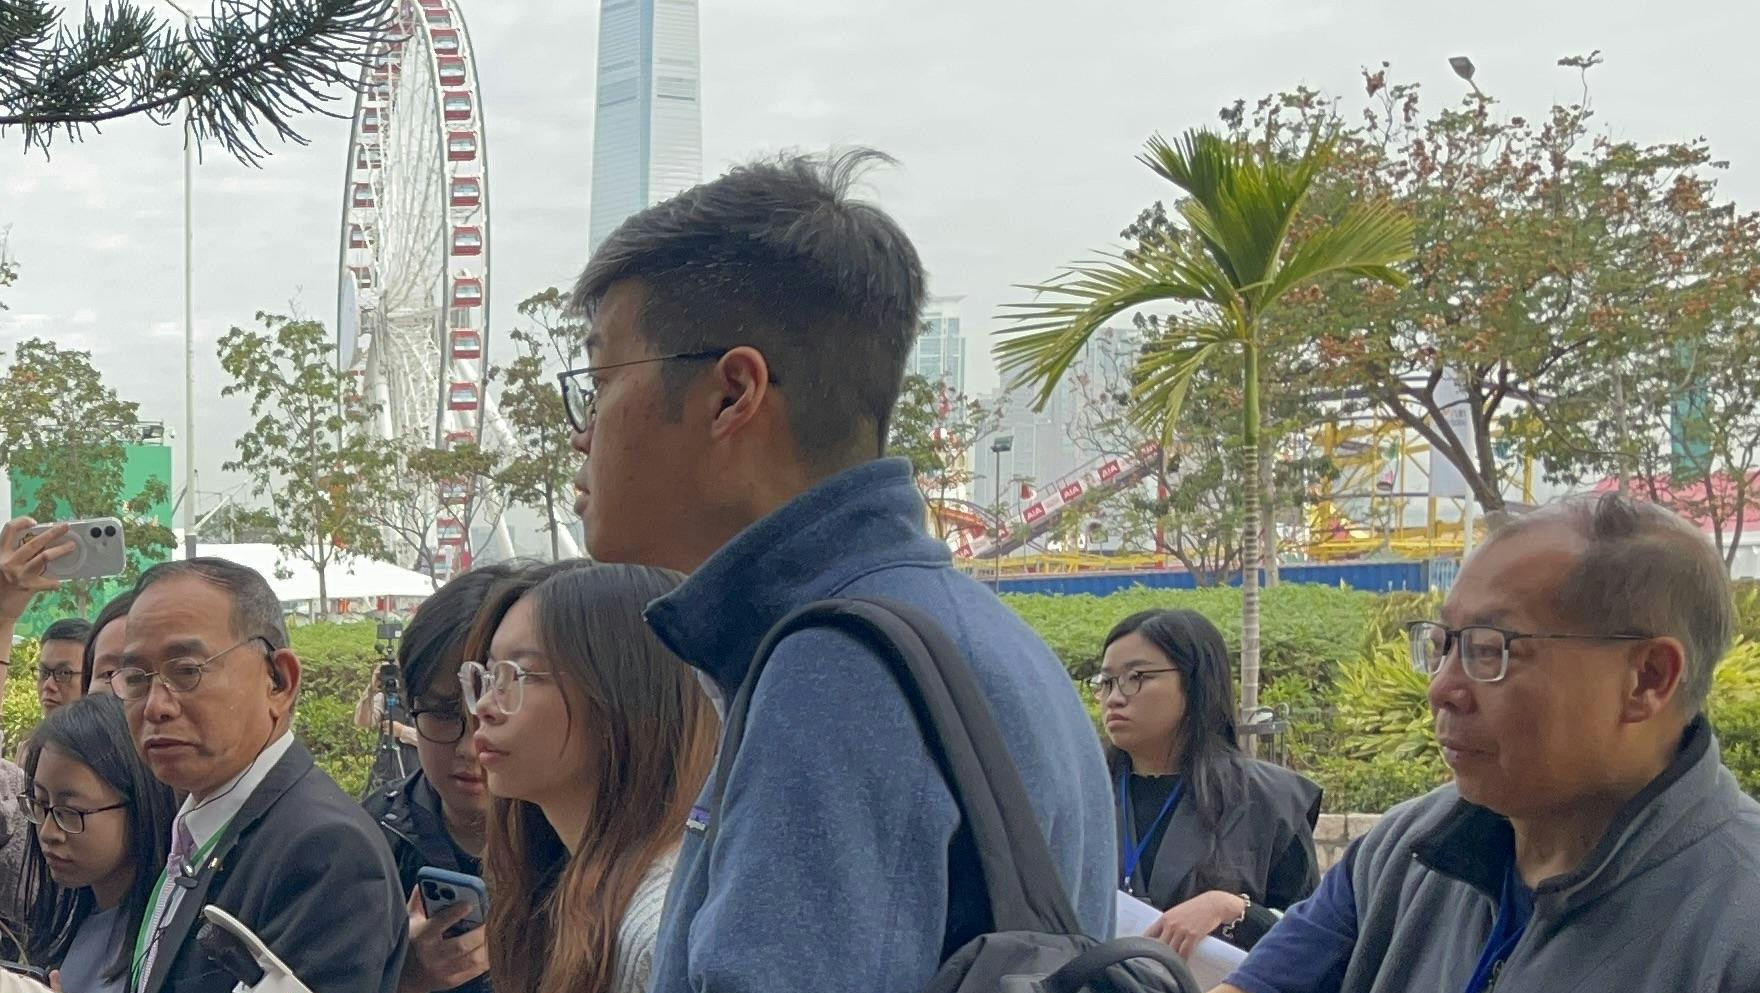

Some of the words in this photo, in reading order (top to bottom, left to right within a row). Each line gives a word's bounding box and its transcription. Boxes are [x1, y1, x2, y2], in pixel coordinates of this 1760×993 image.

[1101, 465, 1119, 479] AIA
[1063, 484, 1080, 499] AIA
[1026, 506, 1043, 520] AIA
